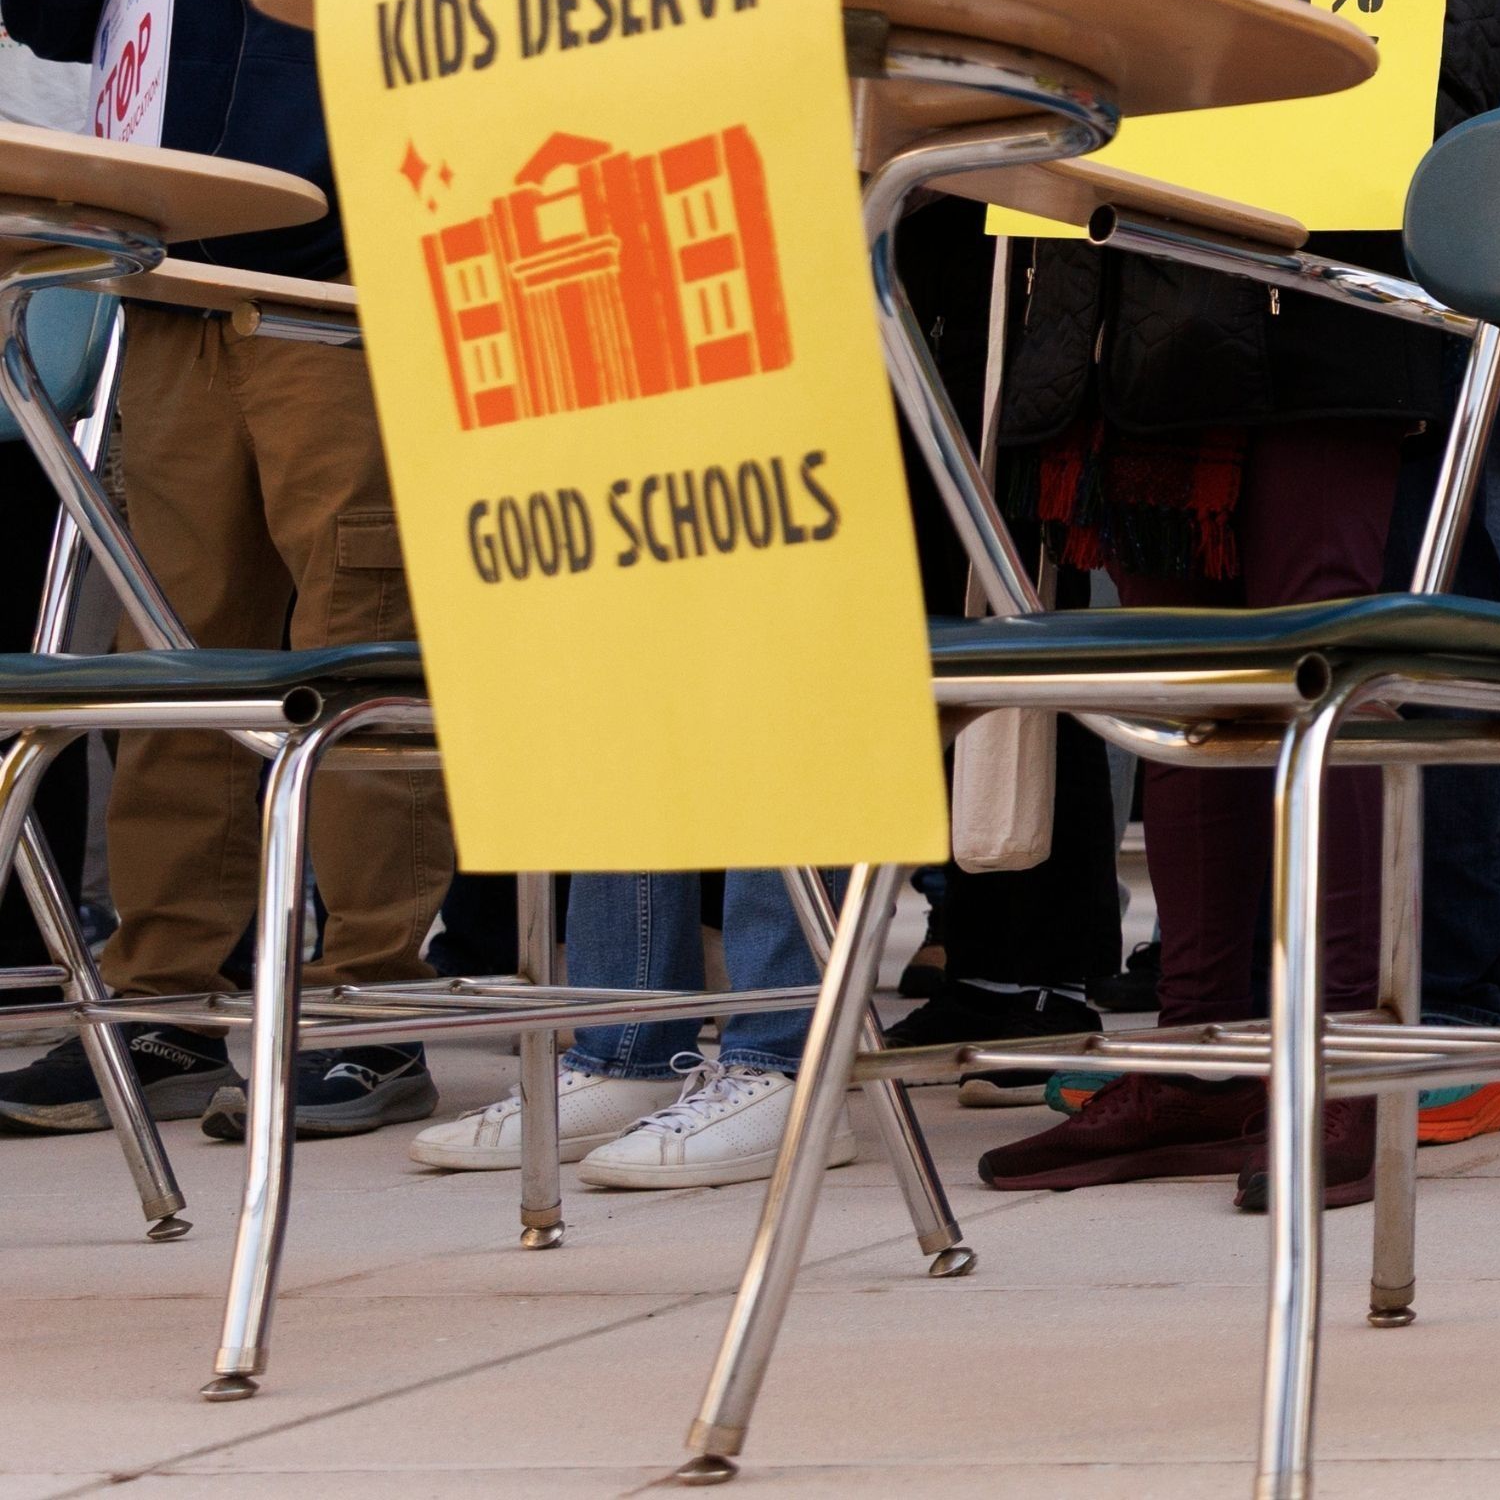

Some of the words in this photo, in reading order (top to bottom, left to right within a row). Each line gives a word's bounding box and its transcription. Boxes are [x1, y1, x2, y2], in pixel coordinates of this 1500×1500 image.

[95, 12, 152, 140] STOP
[466, 487, 595, 585] GOOD
[608, 449, 842, 569] SCHOOLS
[129, 1038, 197, 1071] saucony
